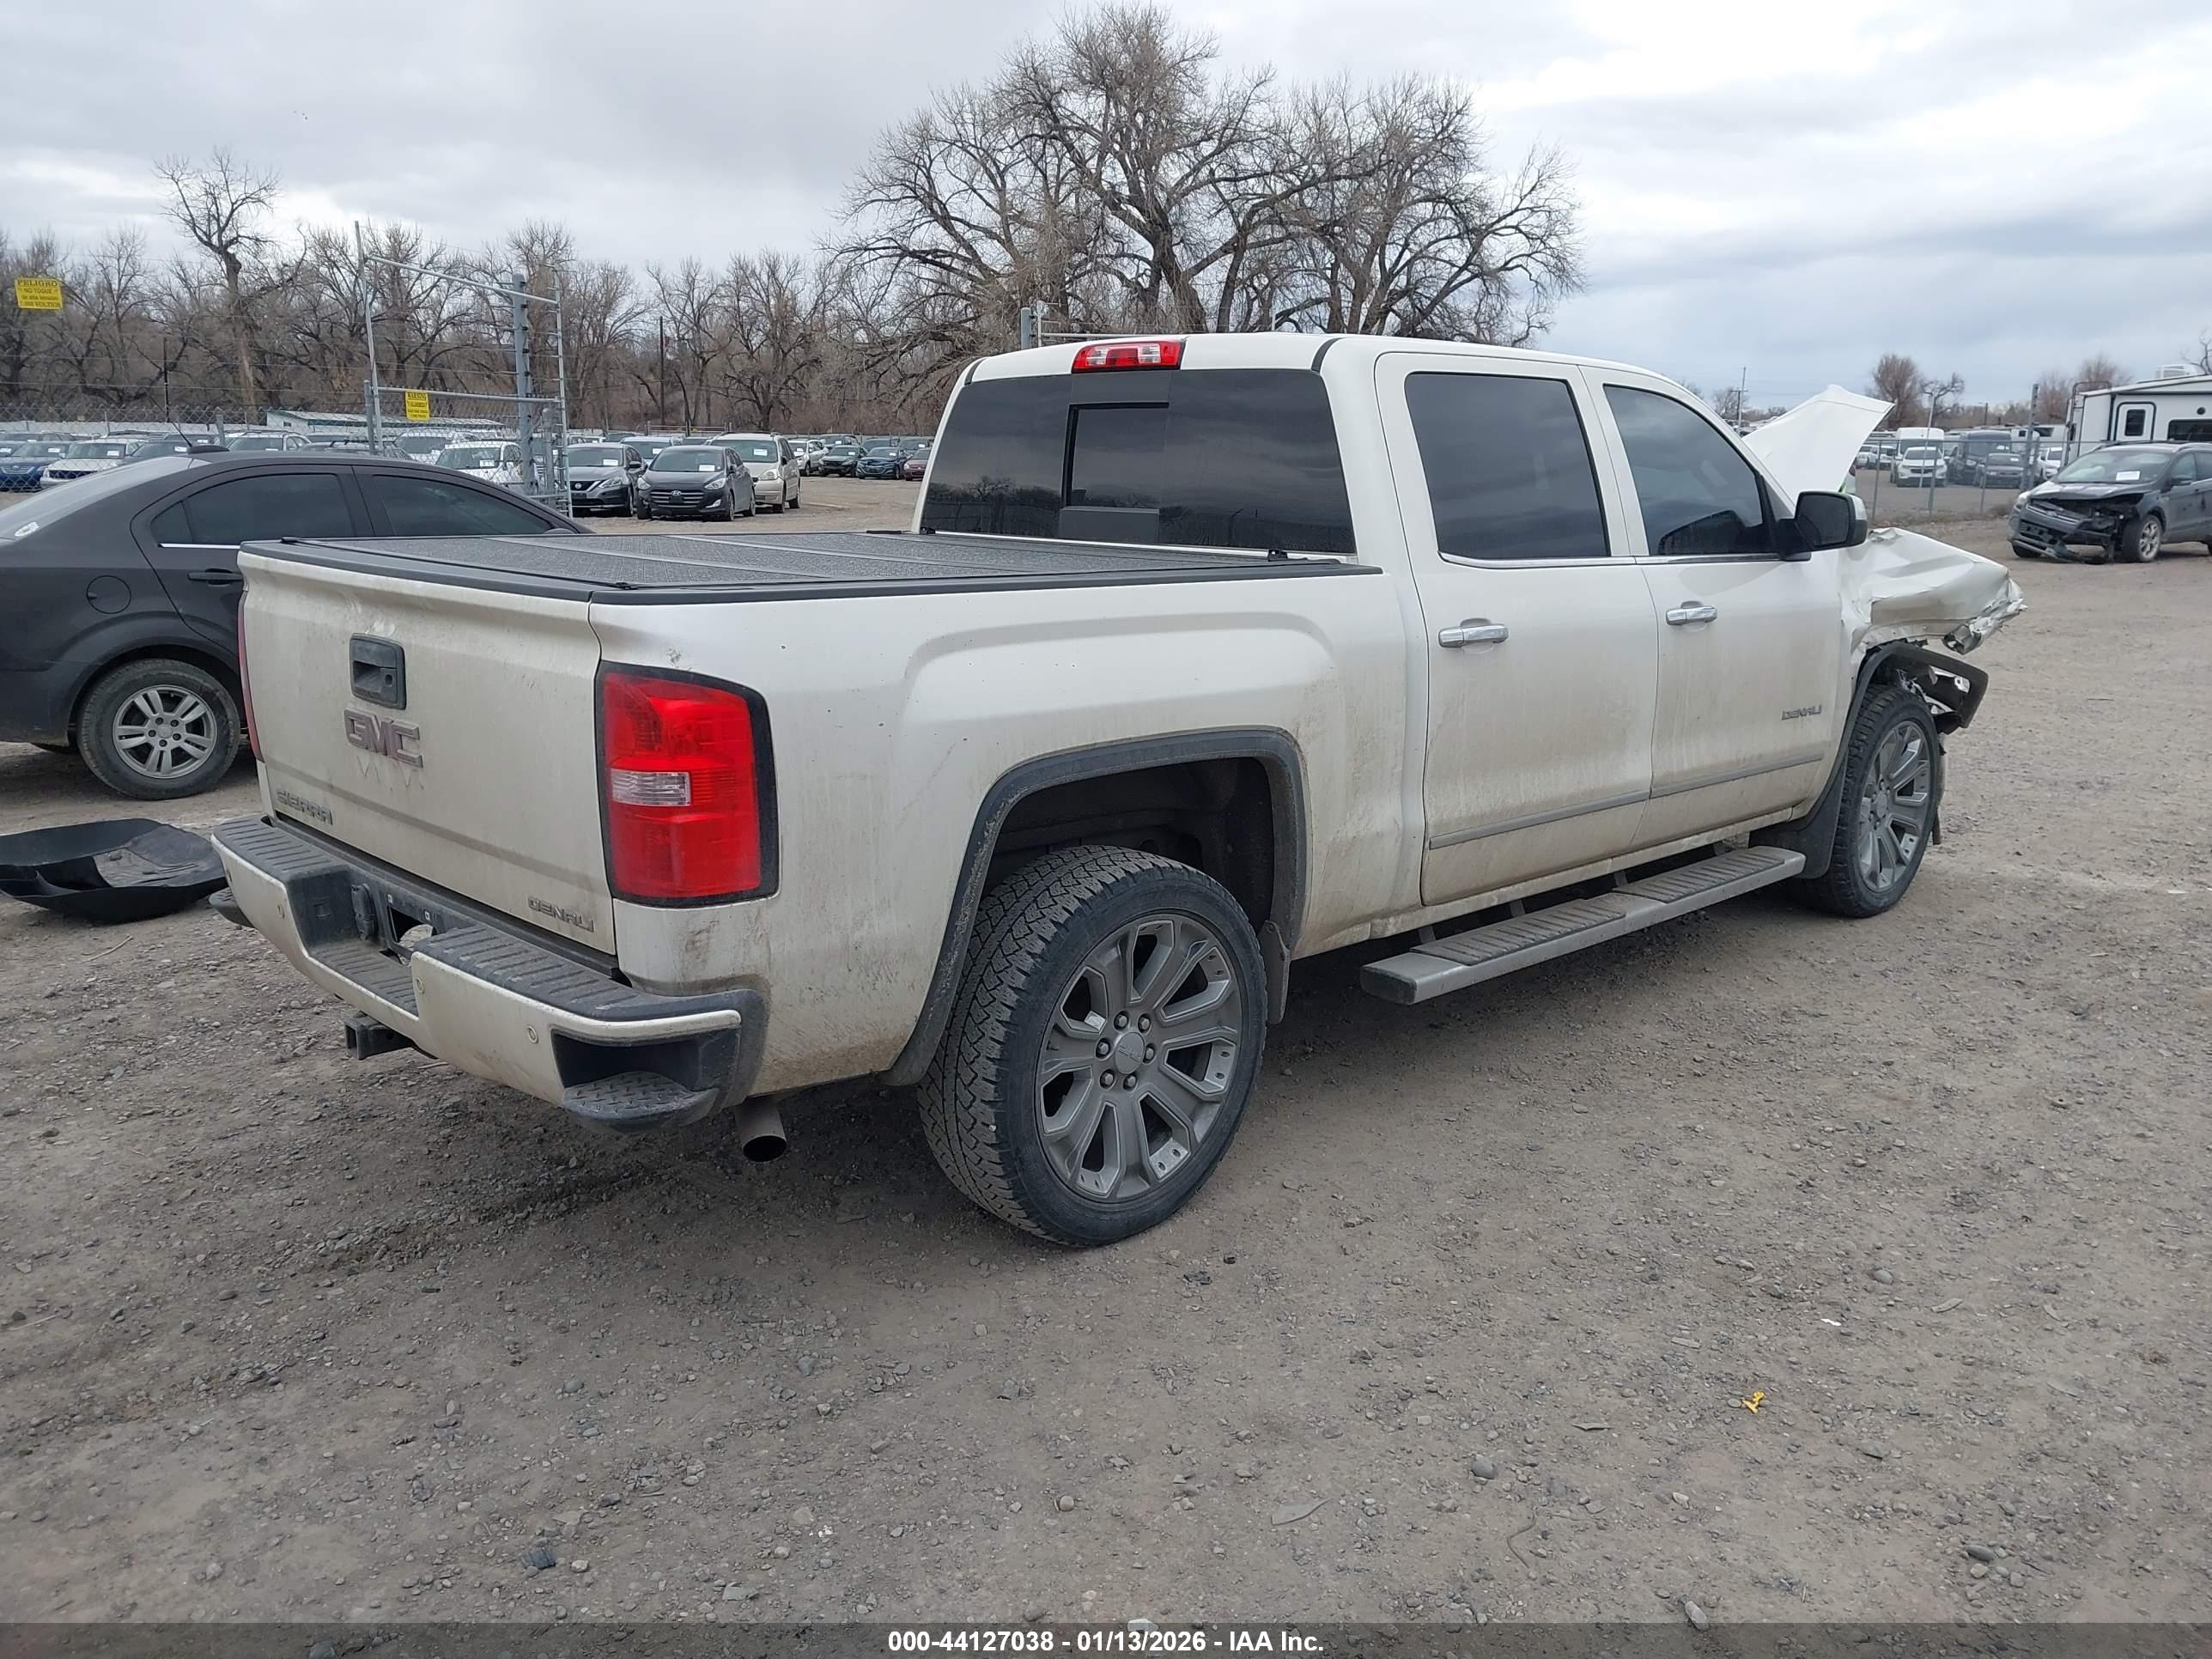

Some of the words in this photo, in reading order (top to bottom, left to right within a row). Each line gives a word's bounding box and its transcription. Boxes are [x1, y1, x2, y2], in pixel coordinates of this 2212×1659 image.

[1781, 704, 1822, 720] DENALI
[343, 708, 423, 769] GMC
[276, 789, 334, 825] SIERRA
[528, 896, 594, 933] DENALI
